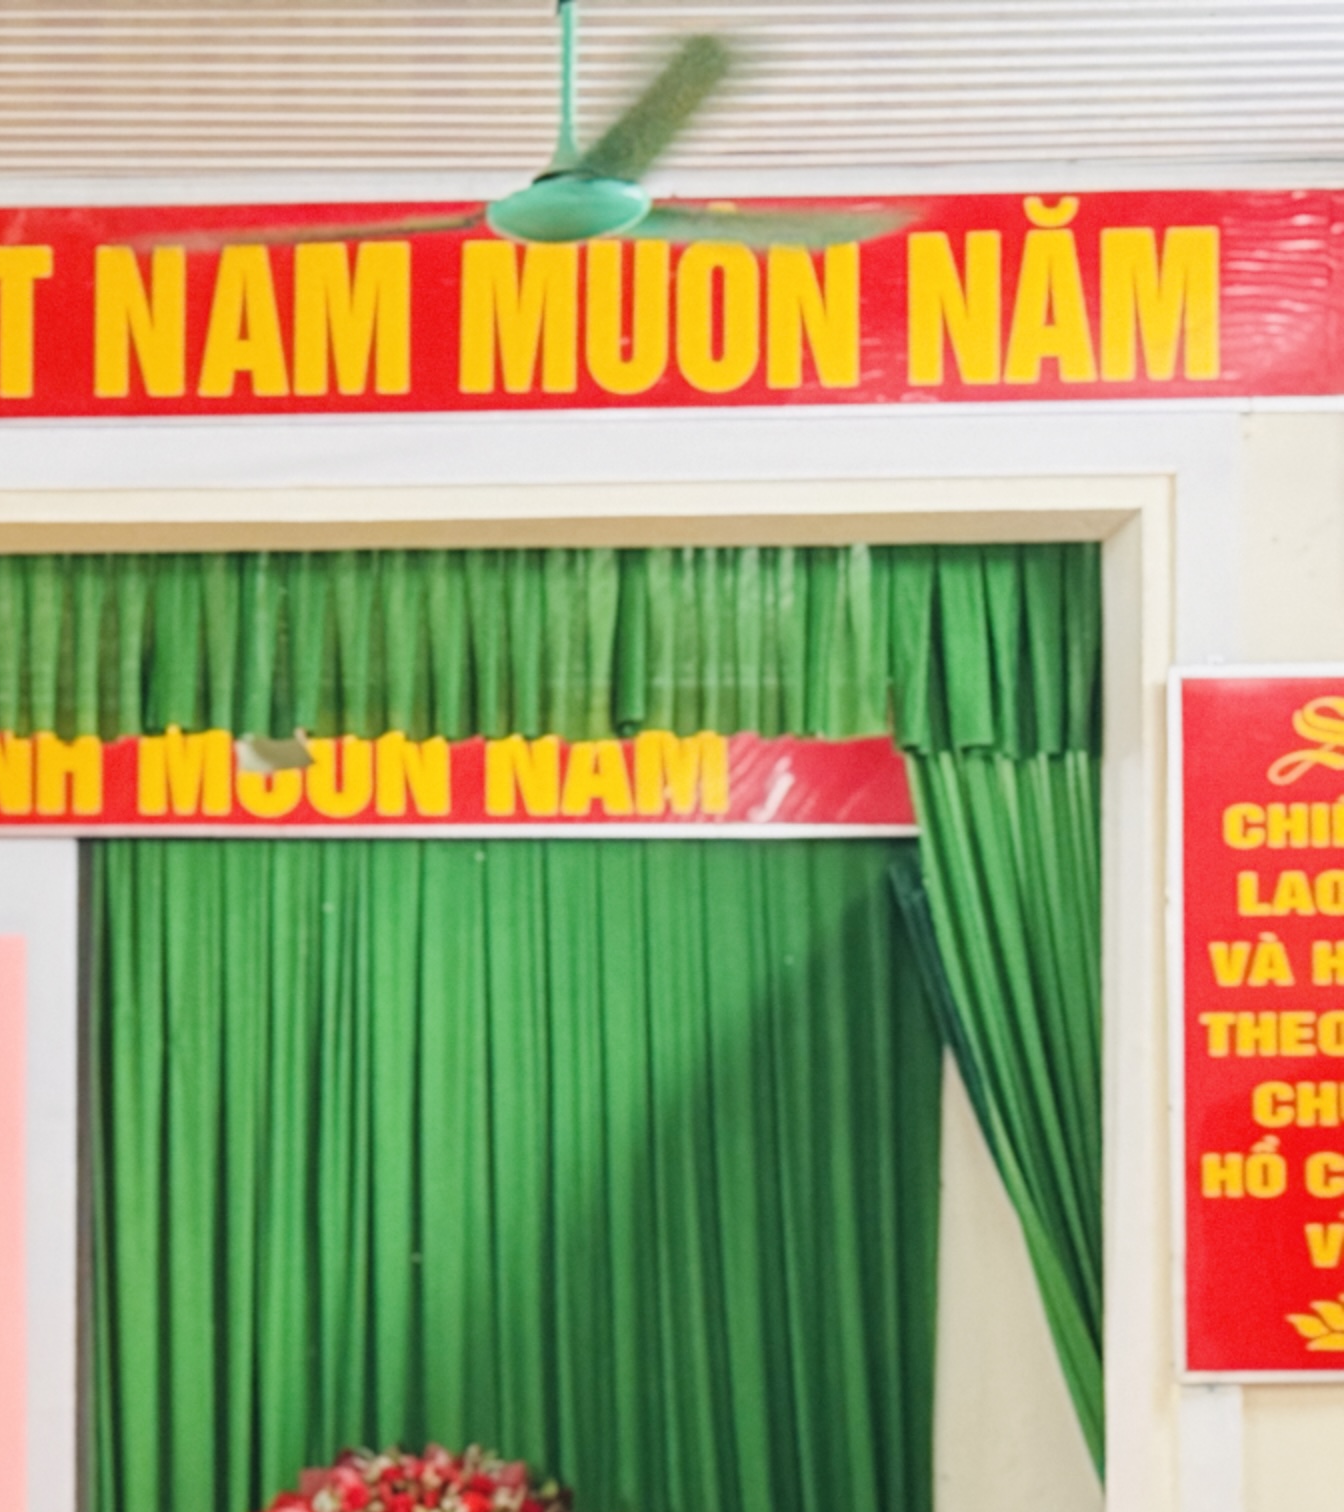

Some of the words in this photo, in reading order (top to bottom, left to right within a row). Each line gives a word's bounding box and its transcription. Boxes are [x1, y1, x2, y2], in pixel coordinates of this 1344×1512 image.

[93, 240, 412, 398] NAM
[908, 196, 1220, 386] NĂM
[1208, 932, 1295, 988] VÀ
[1199, 1135, 1289, 1199] HỒ
